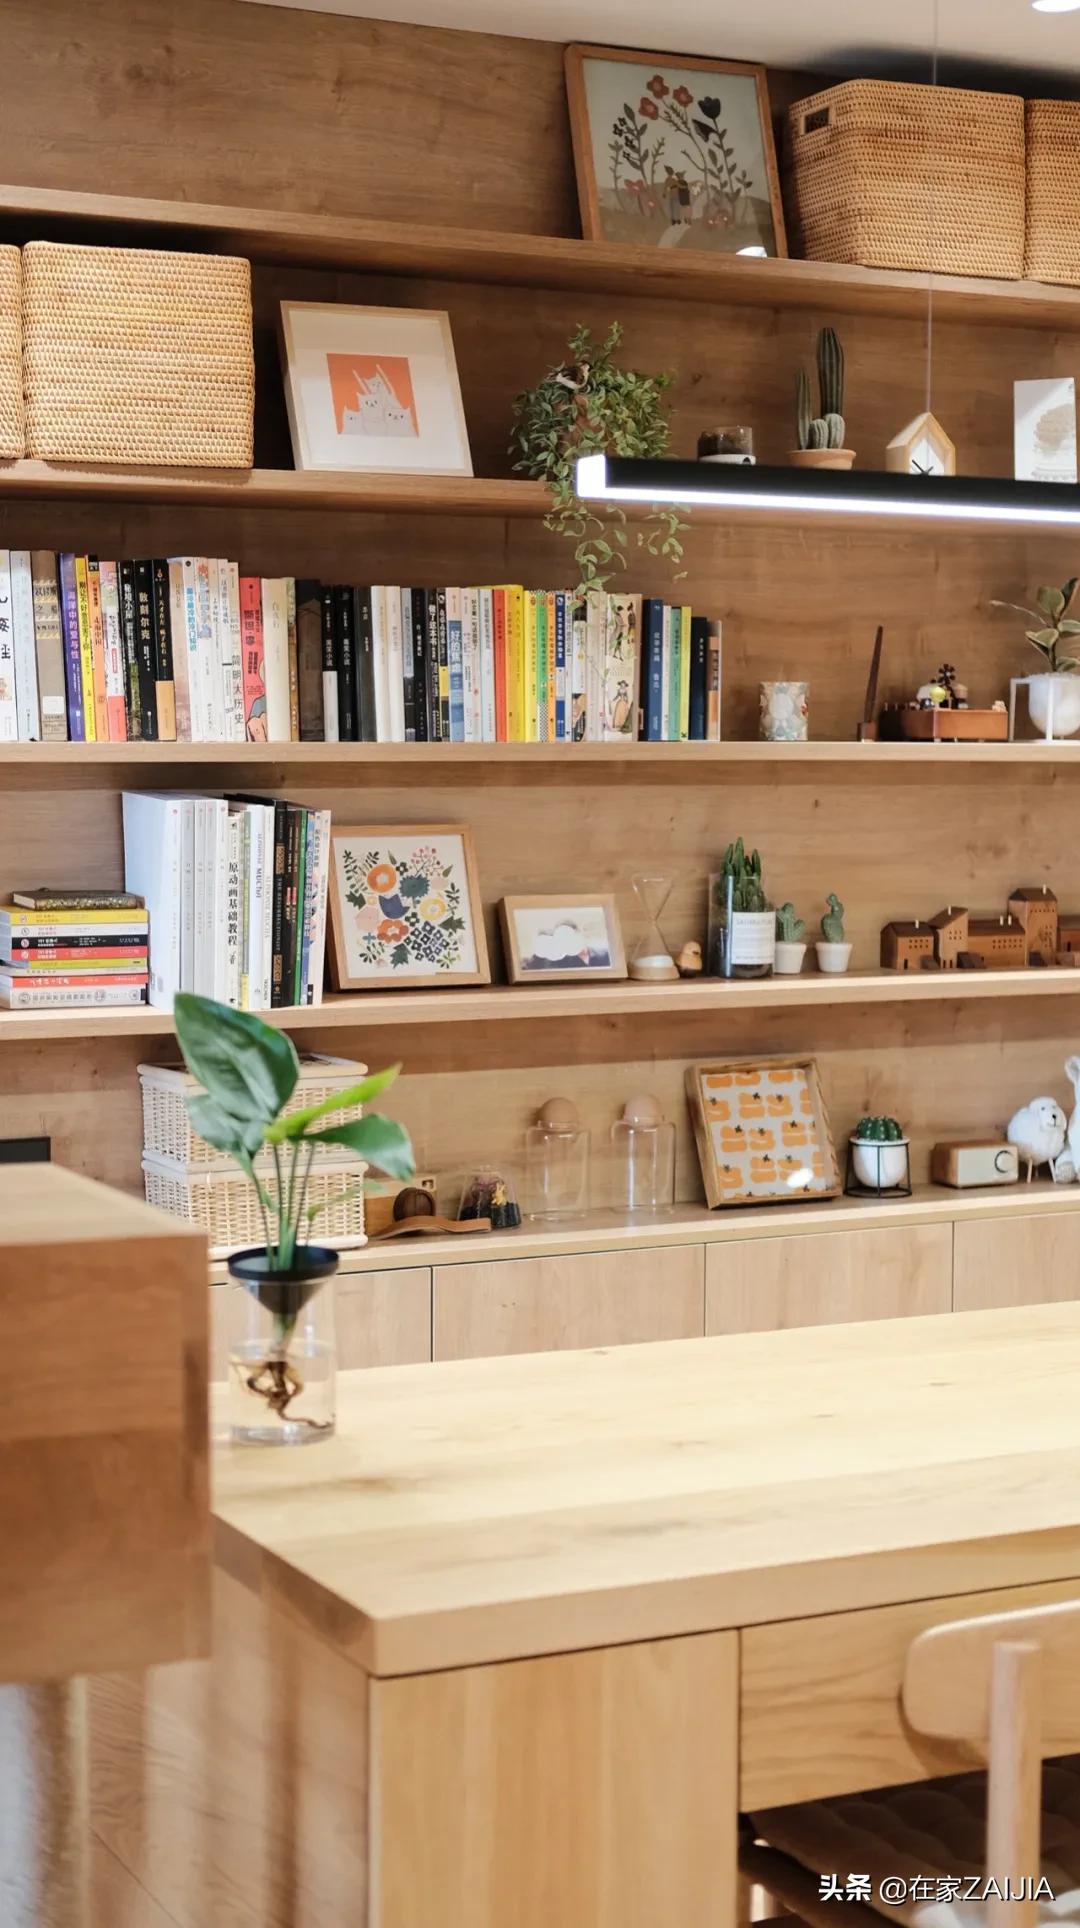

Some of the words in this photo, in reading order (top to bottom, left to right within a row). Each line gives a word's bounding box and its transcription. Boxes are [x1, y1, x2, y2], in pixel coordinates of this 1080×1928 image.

[138, 592, 150, 640] 敦刻尔克
[232, 655, 244, 724] 简明大历史
[227, 861, 238, 946] 原动画基础教程
